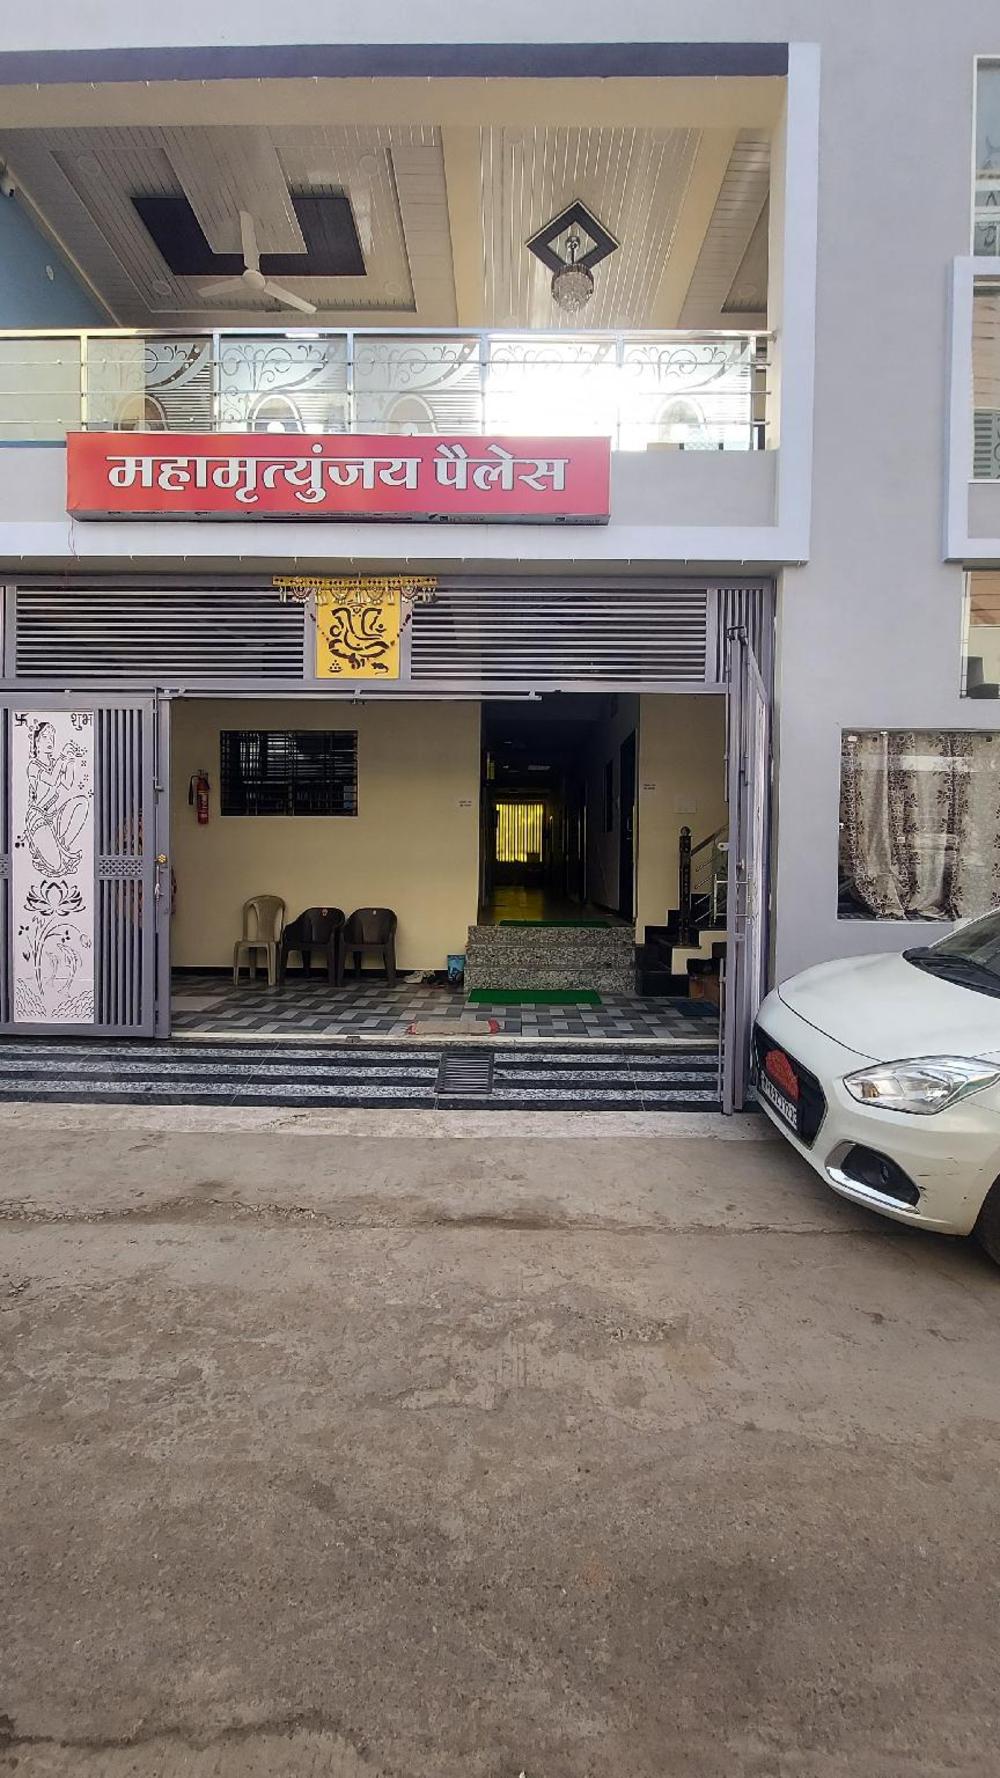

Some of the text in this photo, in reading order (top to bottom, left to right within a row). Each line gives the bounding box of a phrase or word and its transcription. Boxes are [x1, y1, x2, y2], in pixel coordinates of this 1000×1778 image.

[106, 443, 568, 503] महामृत्युंजय पैलेस
[71, 712, 93, 731] शुभ
